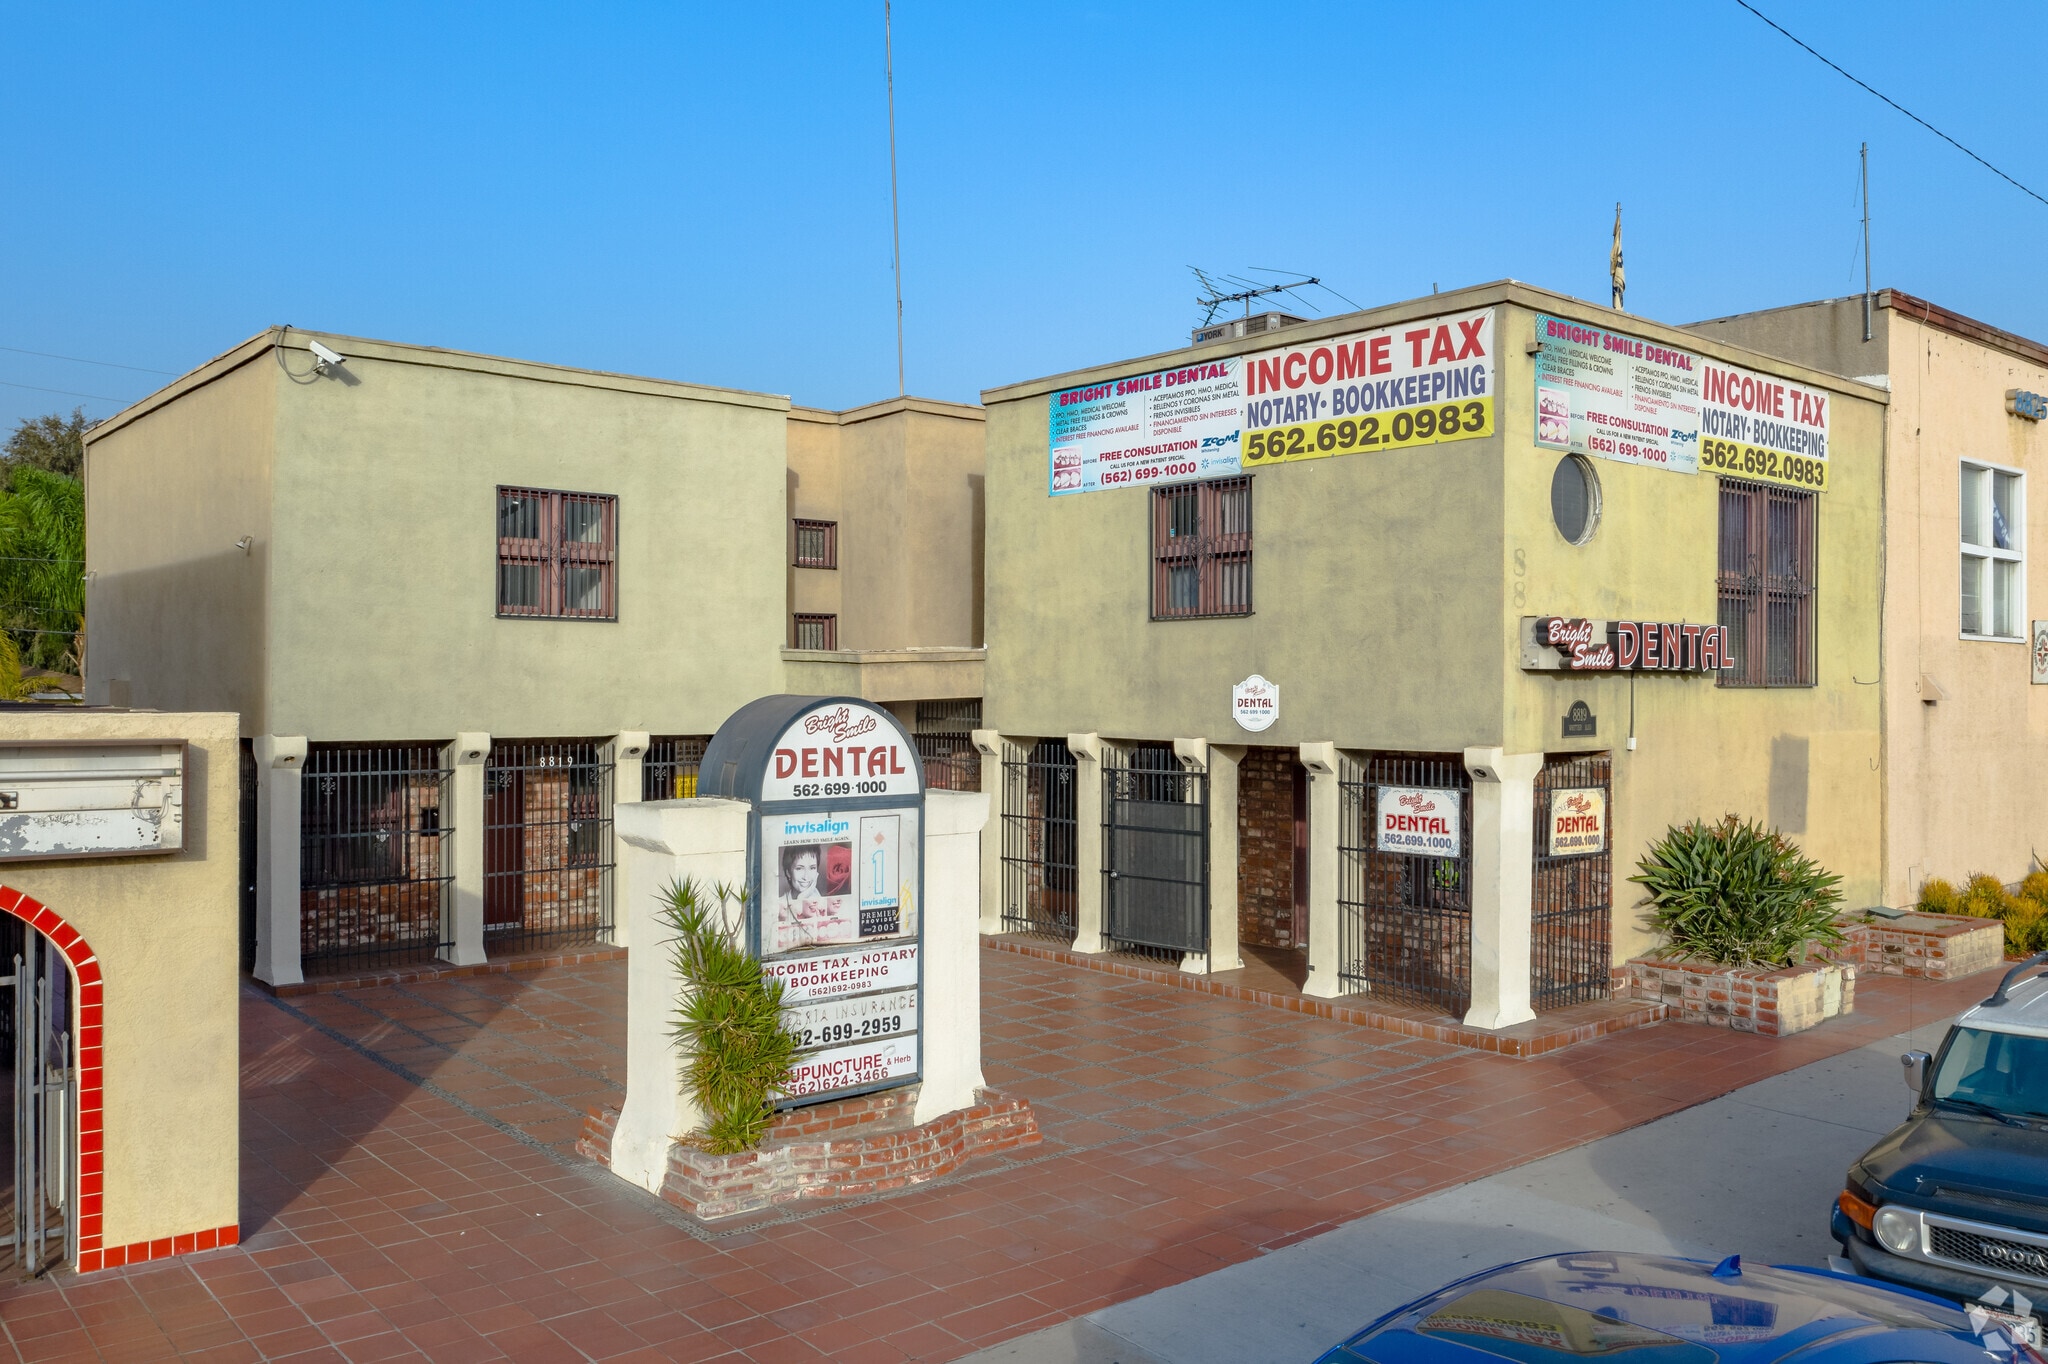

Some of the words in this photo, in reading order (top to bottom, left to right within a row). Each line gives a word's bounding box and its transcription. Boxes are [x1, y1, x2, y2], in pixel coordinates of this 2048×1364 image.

[1203, 327, 1222, 340] YORK
[1546, 320, 1600, 348] BRIGHT
[1602, 333, 1644, 358] SMILE
[1646, 345, 1693, 371] DENTAL
[1246, 335, 1392, 396] INCOME
[1404, 317, 1486, 368] TAX
[1542, 353, 1557, 362] METAL
[1558, 356, 1568, 366] FREE
[1569, 358, 1588, 370] FILLINGS
[1592, 364, 1614, 376] CROWNS
[1568, 348, 1588, 360] MEDICAL
[1588, 353, 1612, 366] WELCOME
[1542, 362, 1556, 372] CLEAR
[1557, 366, 1574, 376] BRACES
[1634, 366, 1660, 378] ACEPTAMOS
[1060, 384, 1113, 407] BRIGHT
[1116, 373, 1162, 396] SMILE
[1166, 362, 1228, 387] DENTAL
[1153, 391, 1184, 402] ACEPTAMOS
[1184, 388, 1197, 397] PPO,
[1198, 386, 1213, 394] HMO,
[1214, 381, 1238, 391] MEDICAL
[1332, 364, 1486, 417] BOOKKEEPING
[1542, 373, 1563, 384] INTEREST
[1563, 378, 1574, 386] FREE
[1574, 380, 1600, 392] FINANCING
[1601, 386, 1623, 397] AVAILABLE
[1634, 384, 1652, 394] FRENOS
[1652, 389, 1672, 399] INVISIBLES
[1658, 380, 1680, 392] CORONAS
[1153, 400, 1178, 410] RELLENOS
[1183, 395, 1210, 406] CORONAS
[1222, 390, 1240, 399] METAL
[1703, 365, 1785, 420] INCOME
[1790, 390, 1826, 428] TAX
[2016, 390, 2048, 420] 8825
[1070, 416, 1080, 424] FREE
[1082, 413, 1100, 422] FILLINGS
[1106, 408, 1128, 418] CROWNS
[1080, 405, 1101, 414] MEDICAL
[1102, 401, 1126, 410] WELCOME
[1153, 410, 1174, 419] FRENOS
[1174, 406, 1200, 416] INVISIBLES
[1153, 414, 1198, 428] FINANCIAMIENTO
[1210, 408, 1238, 418] INTERESES
[1634, 403, 1658, 415] DISPONIBLE
[1678, 402, 1696, 414] INTERESES
[1056, 433, 1075, 442] INTEREST
[1076, 432, 1086, 440] FREE
[1086, 428, 1114, 438] FINANCING
[1114, 424, 1139, 433] AVAILABLE
[1070, 424, 1088, 432] BRACES
[1152, 426, 1182, 436] DISPONIBLE
[1247, 402, 1485, 460] 562.692.0983
[1586, 411, 1608, 425] FREE
[1609, 416, 1668, 438] CONSULTATION
[1588, 434, 1616, 458] (562)
[1618, 444, 1667, 463] 699-1000
[1753, 418, 1825, 458] BOOKKEEPING
[1099, 450, 1122, 462] FREE
[1124, 440, 1198, 458] CONSULTATION
[1168, 454, 1186, 462] SPECIAL
[1100, 469, 1132, 485] (562)
[1135, 462, 1196, 480] 699-1000
[1702, 440, 1824, 487] 562.692.0983
[1548, 616, 1593, 651] Bright
[1570, 643, 1616, 670] Smile
[1618, 621, 1735, 672] DENTAL
[1238, 698, 1273, 708] DENTAL
[804, 706, 850, 735] Bright
[1572, 708, 1587, 722] 8819
[833, 715, 877, 744] Smile
[540, 756, 573, 768] 8819
[775, 745, 906, 780] DENTAL
[784, 819, 849, 835] invisalign
[1386, 814, 1450, 836] DENTAL
[1556, 816, 1599, 834] DENTAL
[1384, 833, 1452, 849] 562.699.1000
[872, 850, 884, 895] 1
[862, 896, 897, 907] invisalign
[861, 910, 897, 920] PREMIER
[872, 922, 894, 933] 2005
[822, 956, 850, 970] TAX
[862, 948, 917, 966] NOTARY
[790, 966, 889, 988] BOOKKEEPING
[808, 980, 872, 997] (562)692-0983
[792, 1014, 902, 1047] 62-699-2959
[778, 1053, 882, 1086] CUPUNCTURE
[886, 1058, 892, 1066] &
[894, 1054, 912, 1064] Herb
[1979, 1242, 2046, 1268] TOYOTA
